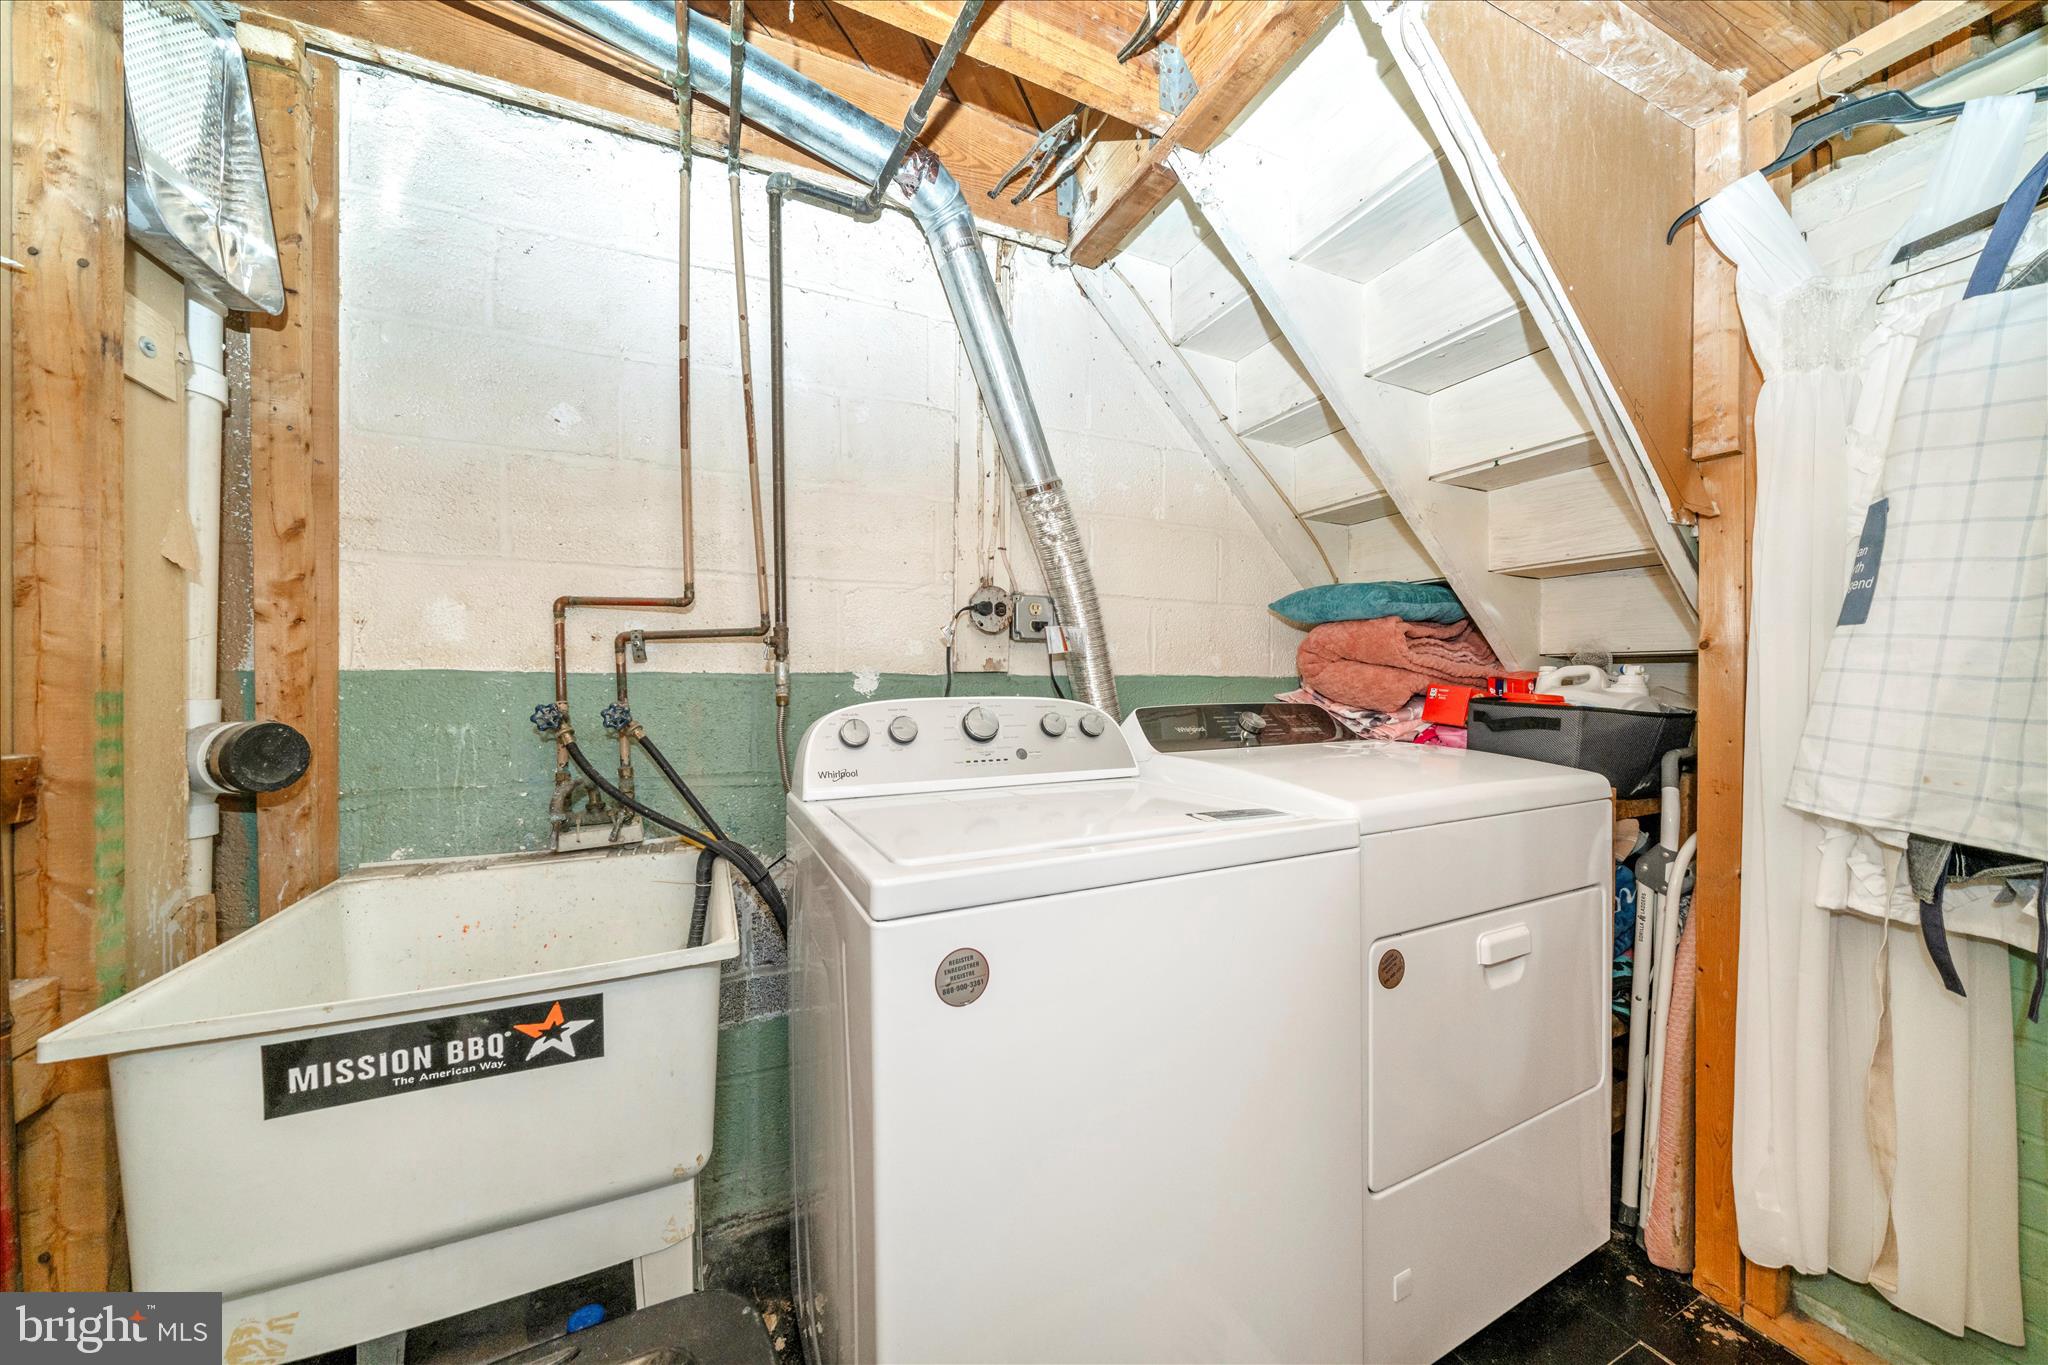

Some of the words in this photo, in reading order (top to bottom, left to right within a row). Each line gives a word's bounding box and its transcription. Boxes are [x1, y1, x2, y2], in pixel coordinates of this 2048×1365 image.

[818, 769, 859, 782] Whirlpool
[948, 955, 974, 966] REGISTER
[288, 1045, 432, 1094] MISSION
[447, 1033, 504, 1065] BBQ
[392, 1077, 415, 1087] The
[419, 1065, 476, 1082] American
[480, 1060, 507, 1072] Way.
